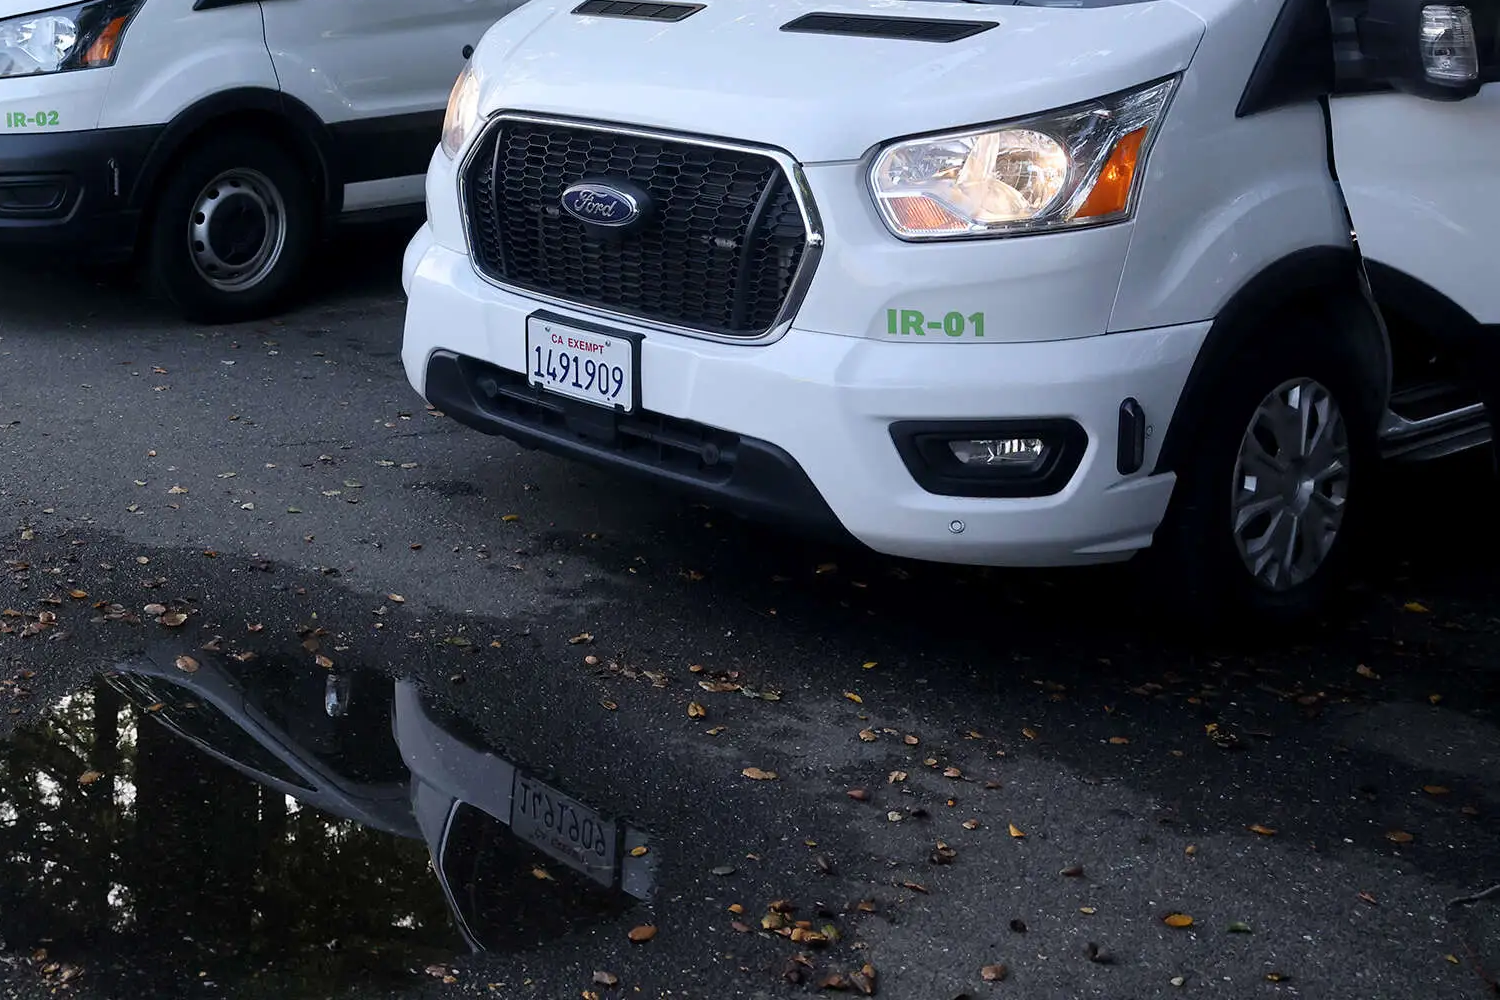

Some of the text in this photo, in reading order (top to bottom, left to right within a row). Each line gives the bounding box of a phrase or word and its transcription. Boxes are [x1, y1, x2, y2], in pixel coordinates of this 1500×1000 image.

[6, 110, 60, 128] IR-02
[574, 189, 618, 217] Ford
[887, 309, 984, 337] IR-01
[551, 334, 605, 354] CA EXEMPT
[534, 346, 624, 398] 1491909
